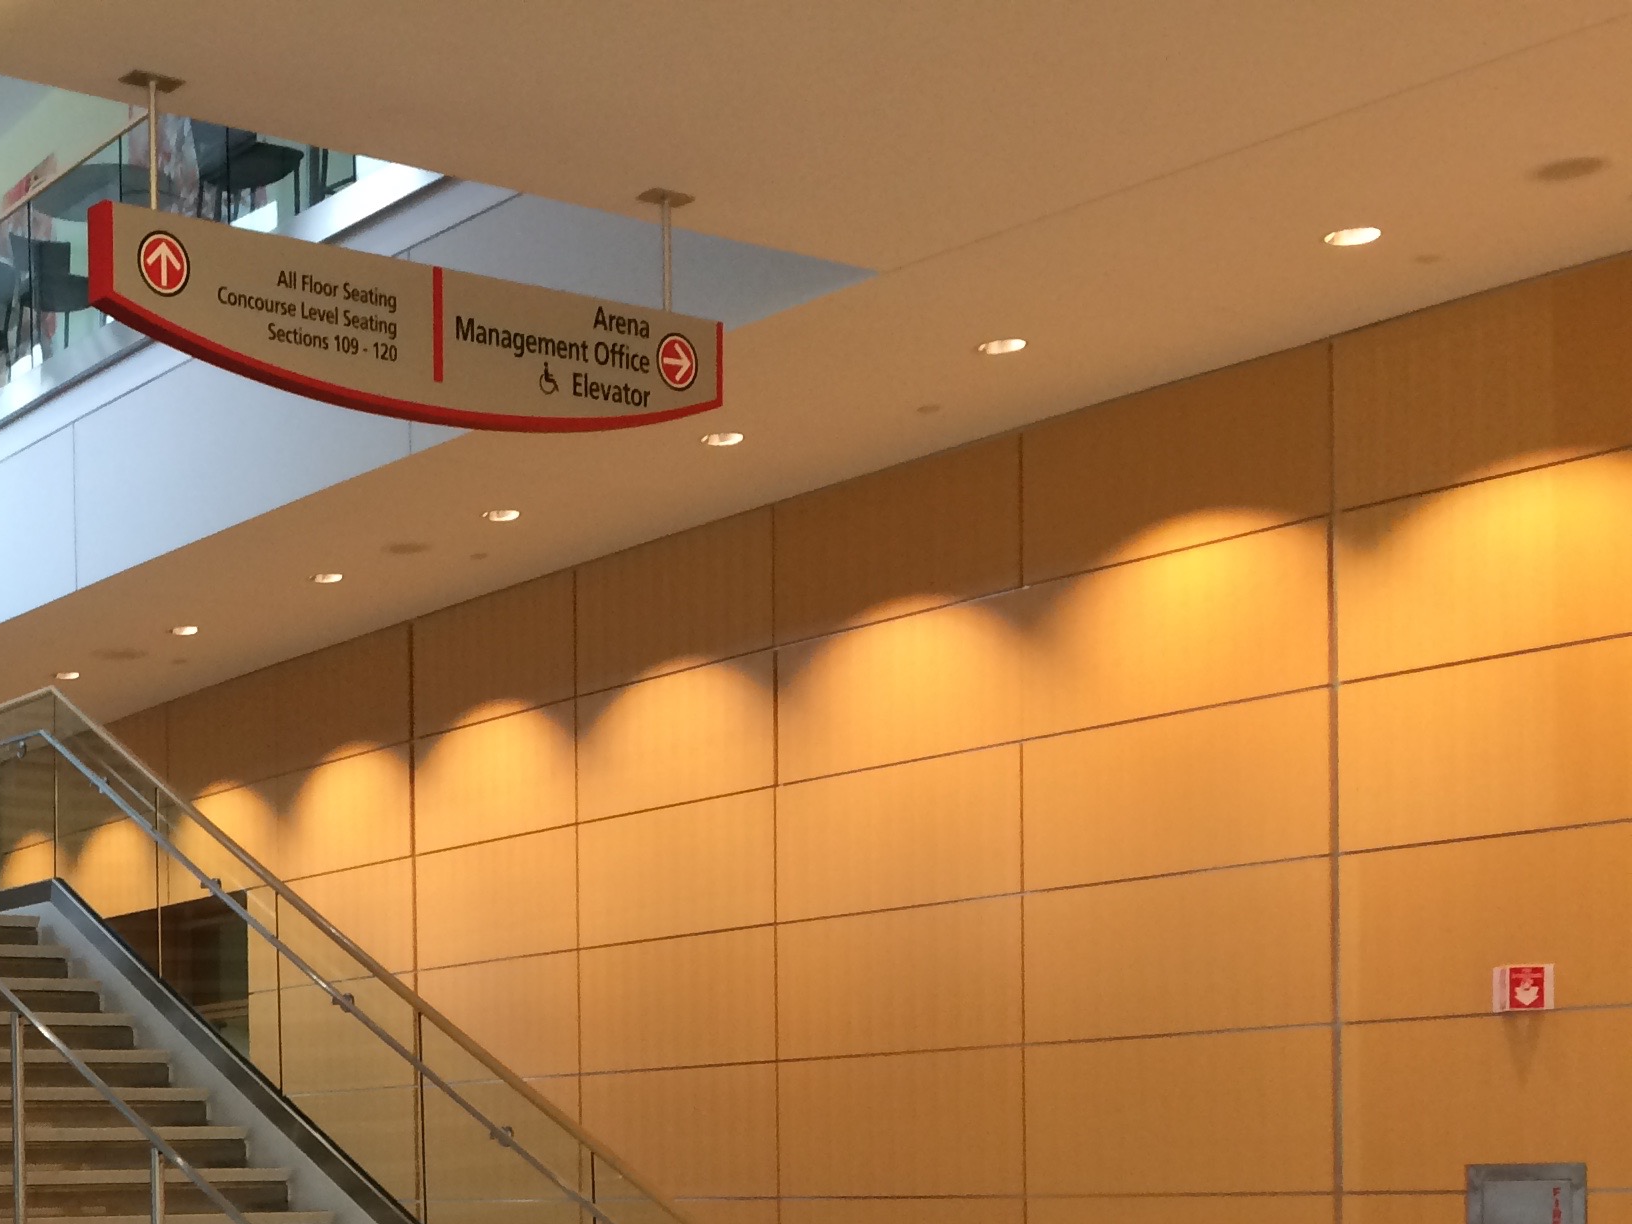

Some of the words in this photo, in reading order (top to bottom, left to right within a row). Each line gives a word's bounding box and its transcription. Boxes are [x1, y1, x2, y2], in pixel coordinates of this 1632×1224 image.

[276, 270, 297, 290] All
[301, 274, 339, 298] Floor
[342, 282, 398, 313] Seating
[217, 286, 297, 317] Concourse
[300, 301, 339, 325] Level
[342, 309, 398, 340] Seating
[593, 305, 650, 339] Arena
[267, 322, 329, 350] Sections
[334, 334, 359, 355] 109
[372, 342, 398, 362] 120
[455, 315, 589, 363] Management
[594, 341, 650, 374] Office
[572, 372, 651, 407] Elevator
